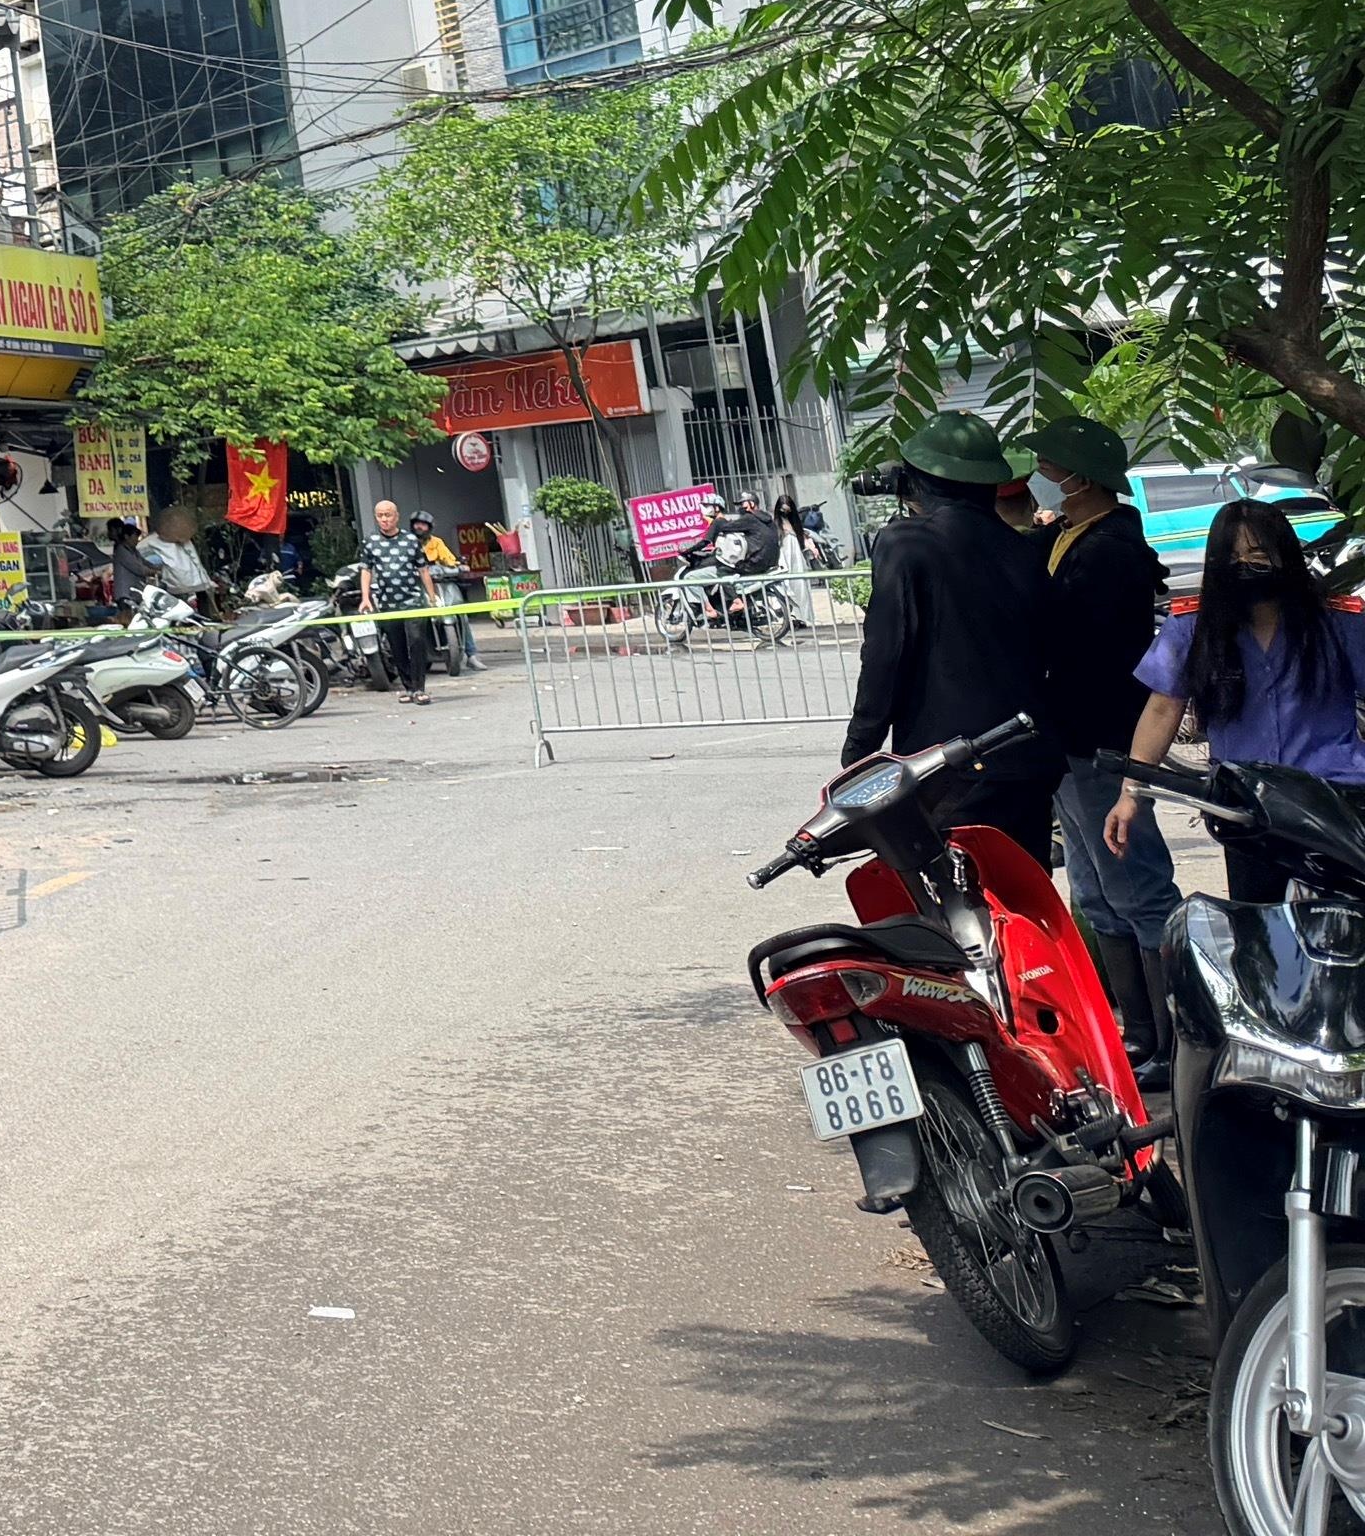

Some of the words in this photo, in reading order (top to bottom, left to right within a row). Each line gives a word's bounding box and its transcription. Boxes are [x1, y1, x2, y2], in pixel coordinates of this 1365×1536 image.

[8, 279, 48, 330] NGAN
[48, 276, 69, 332] GÀ
[69, 273, 88, 334] SỐ
[88, 291, 99, 336] 6
[637, 501, 663, 521] SPA
[642, 513, 704, 536] MASSAGE
[1017, 964, 1054, 983] HONDA
[816, 1050, 895, 1097] 86-F8
[825, 1084, 905, 1132] 8866
